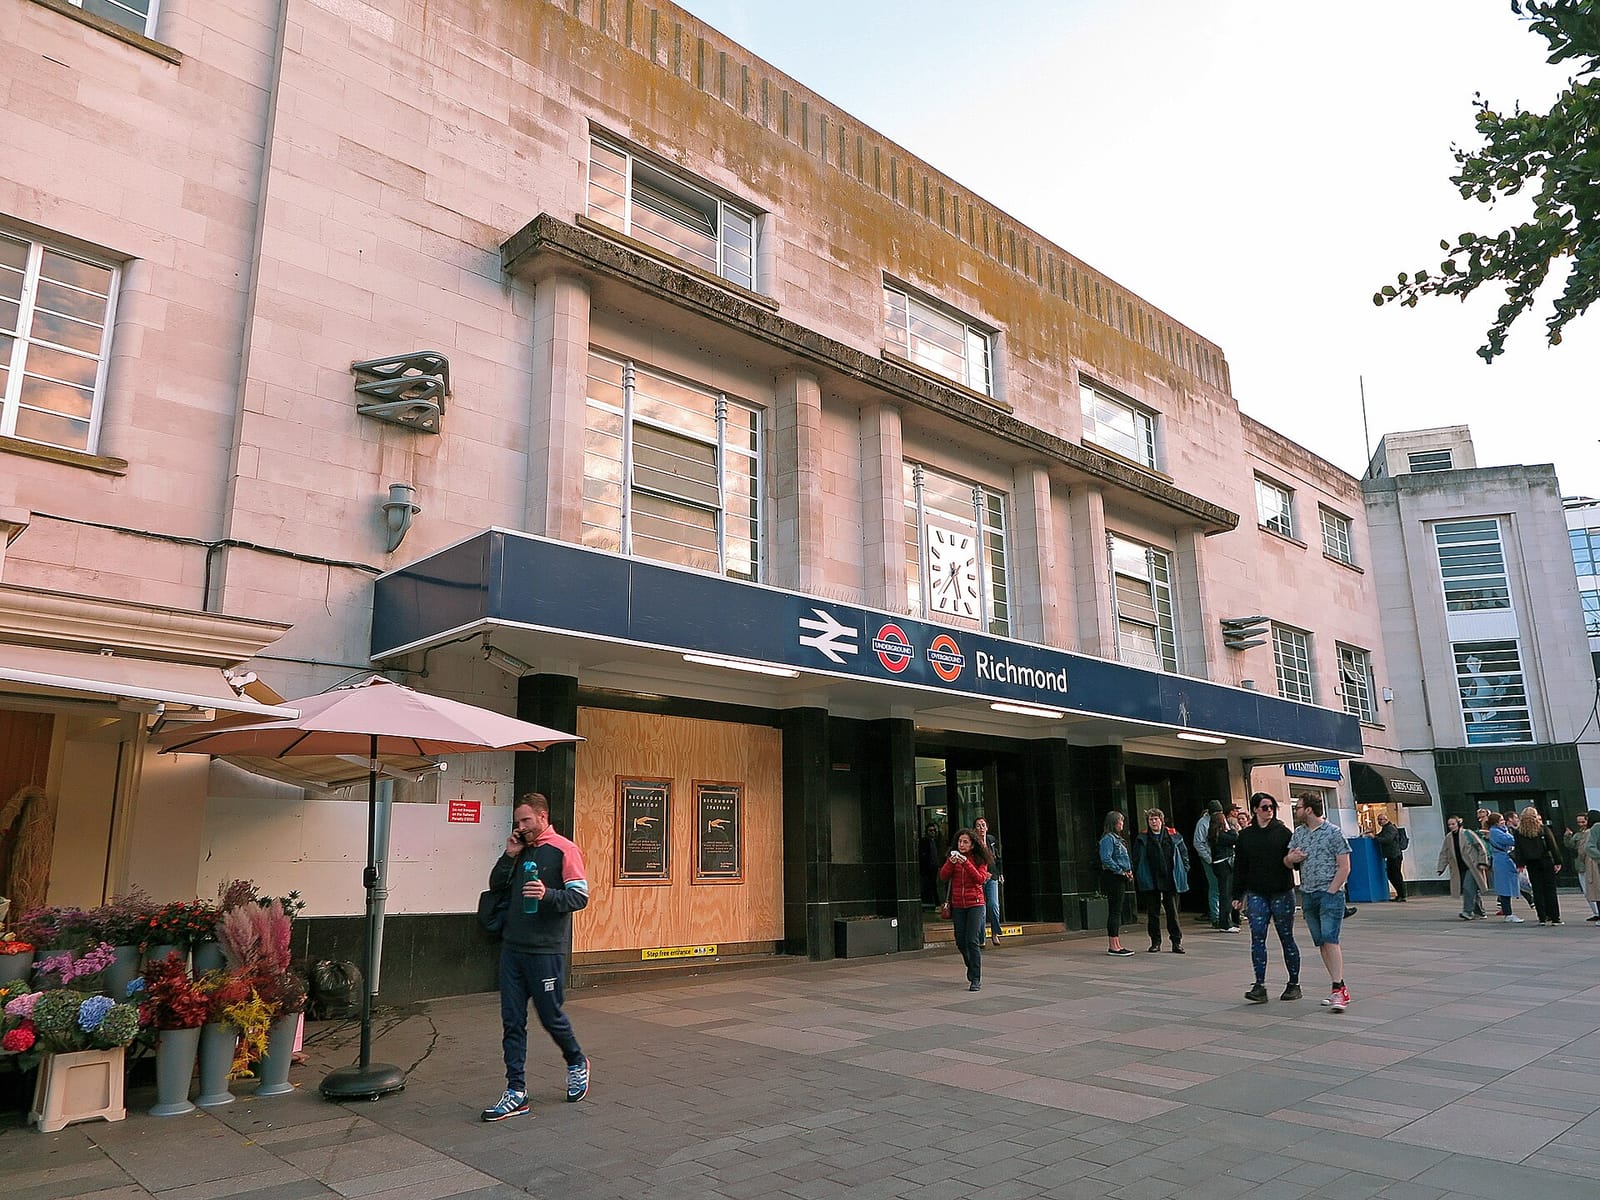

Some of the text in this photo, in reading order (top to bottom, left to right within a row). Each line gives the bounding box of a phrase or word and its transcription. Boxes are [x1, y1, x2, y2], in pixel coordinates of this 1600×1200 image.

[874, 641, 912, 654] UNDERGROUND
[930, 652, 962, 664] OVERGROUND
[976, 651, 1068, 693] Richmond
[1319, 765, 1340, 775] EXPRESS
[1495, 767, 1526, 776] STATION
[1494, 775, 1530, 783] BUILDING
